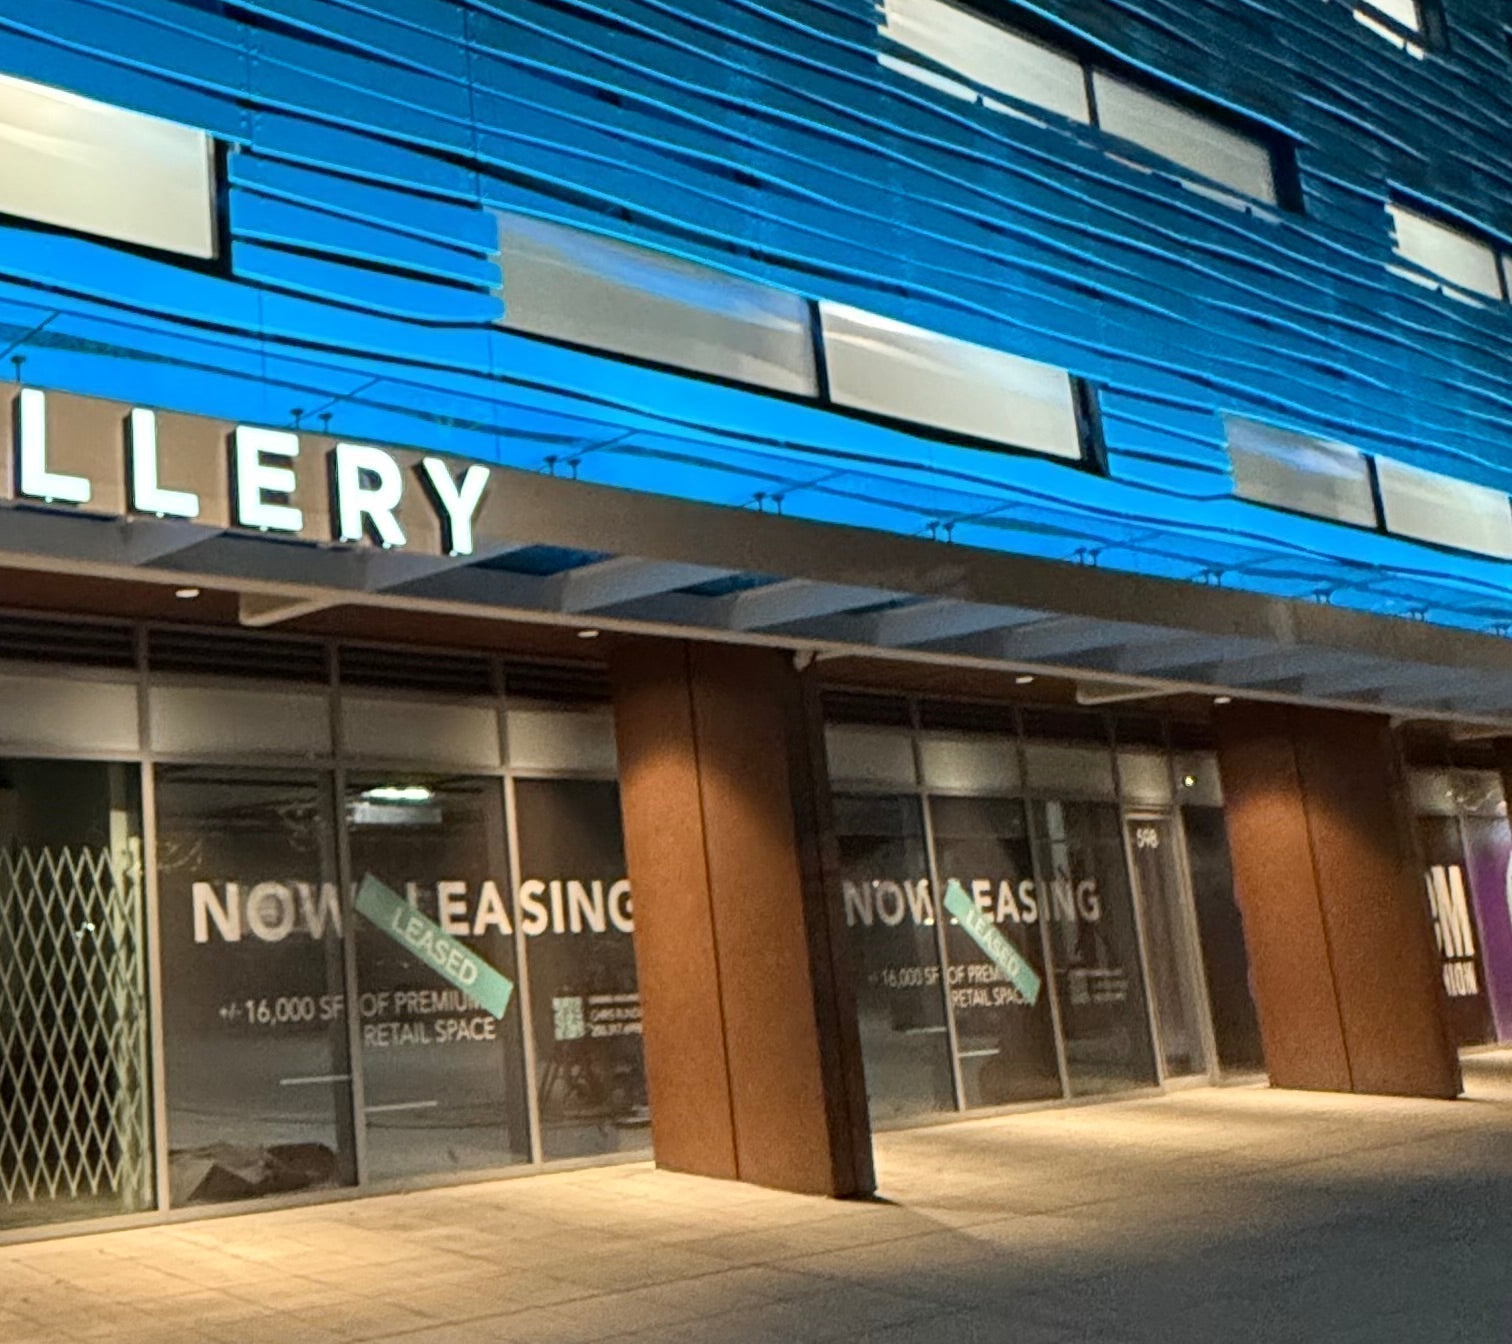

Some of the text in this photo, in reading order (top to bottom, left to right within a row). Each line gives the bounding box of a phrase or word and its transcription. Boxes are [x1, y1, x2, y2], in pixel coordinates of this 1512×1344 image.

[192, 880, 356, 943] NOW
[951, 879, 1101, 924] EASING
[391, 907, 479, 985] LEASED
[245, 998, 315, 1025] 16,000
[319, 995, 345, 1020] SF
[359, 993, 390, 1017] OF
[363, 1016, 497, 1047] RETAIL SPACE
